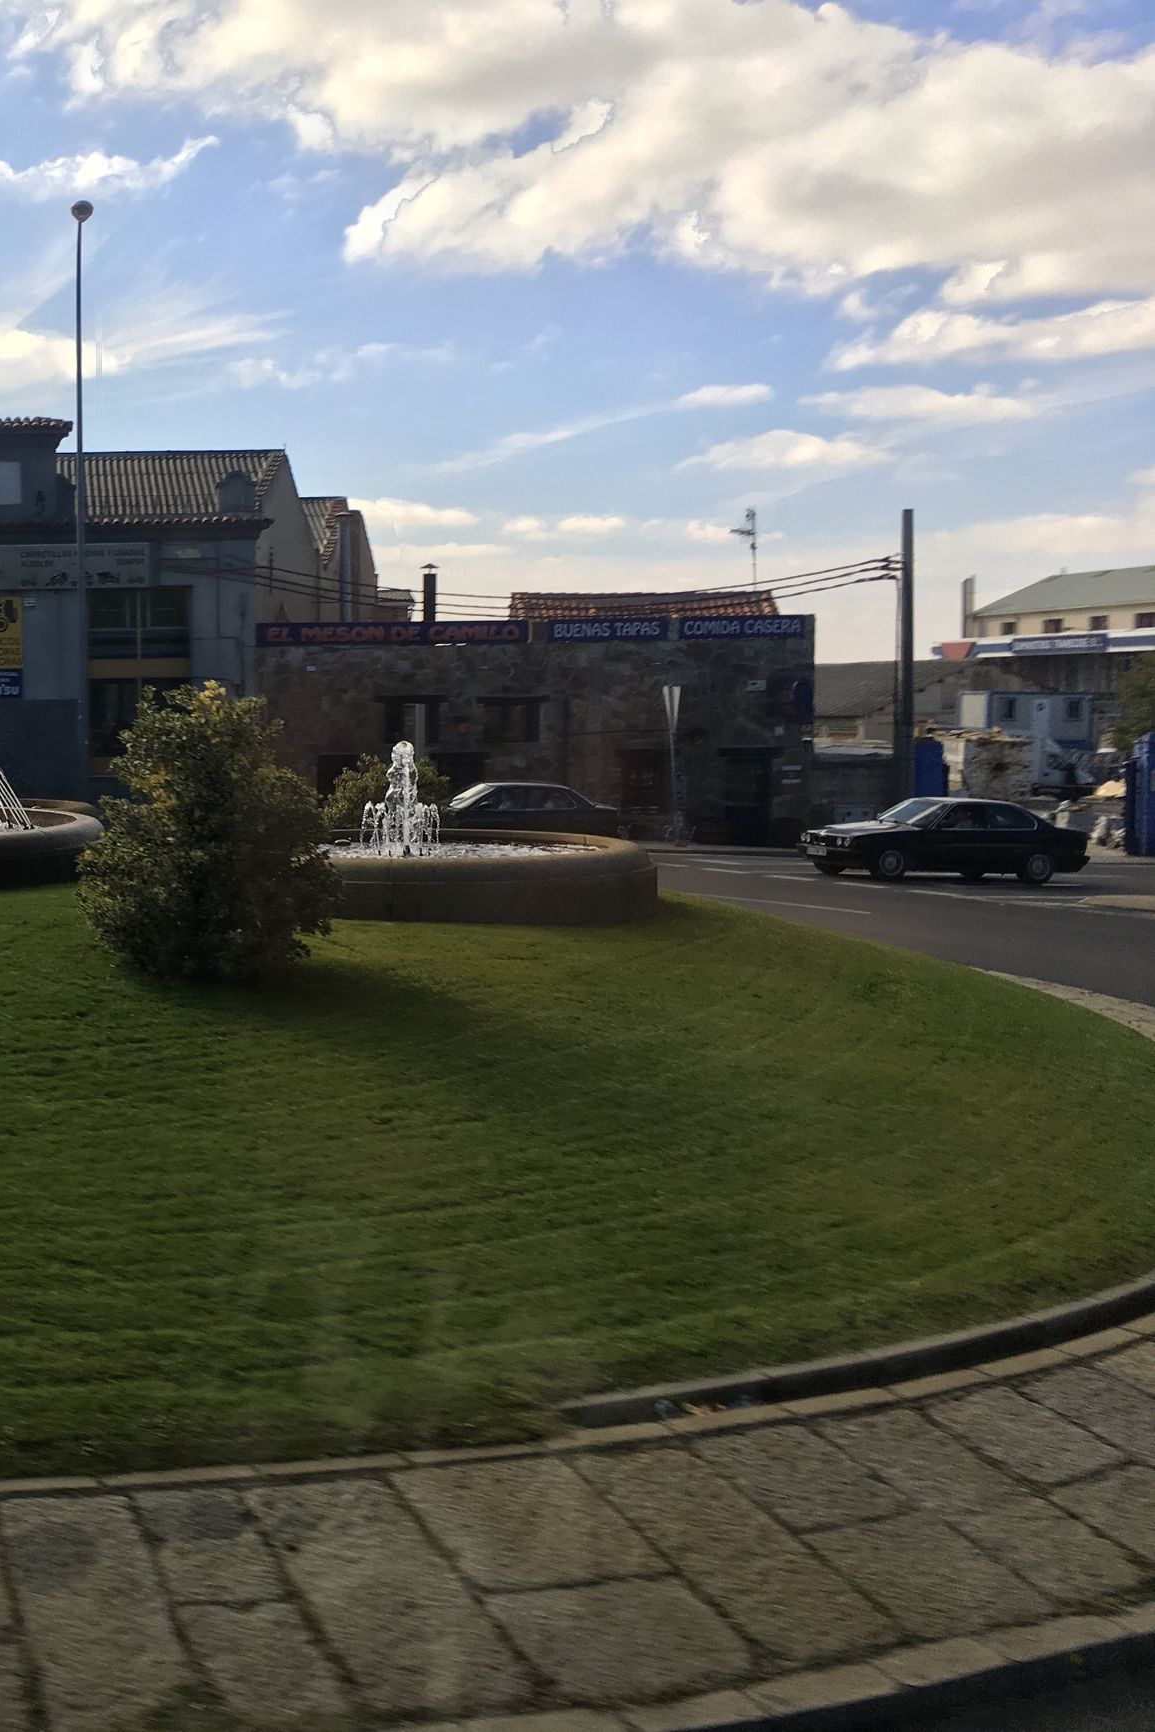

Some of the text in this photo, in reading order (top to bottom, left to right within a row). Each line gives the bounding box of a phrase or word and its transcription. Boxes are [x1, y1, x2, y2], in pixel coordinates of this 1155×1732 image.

[267, 624, 522, 643] EL MESON DE CAMILO
[553, 621, 661, 639] BUENAS TAPAS
[683, 618, 803, 636] COMIDA CASERA
